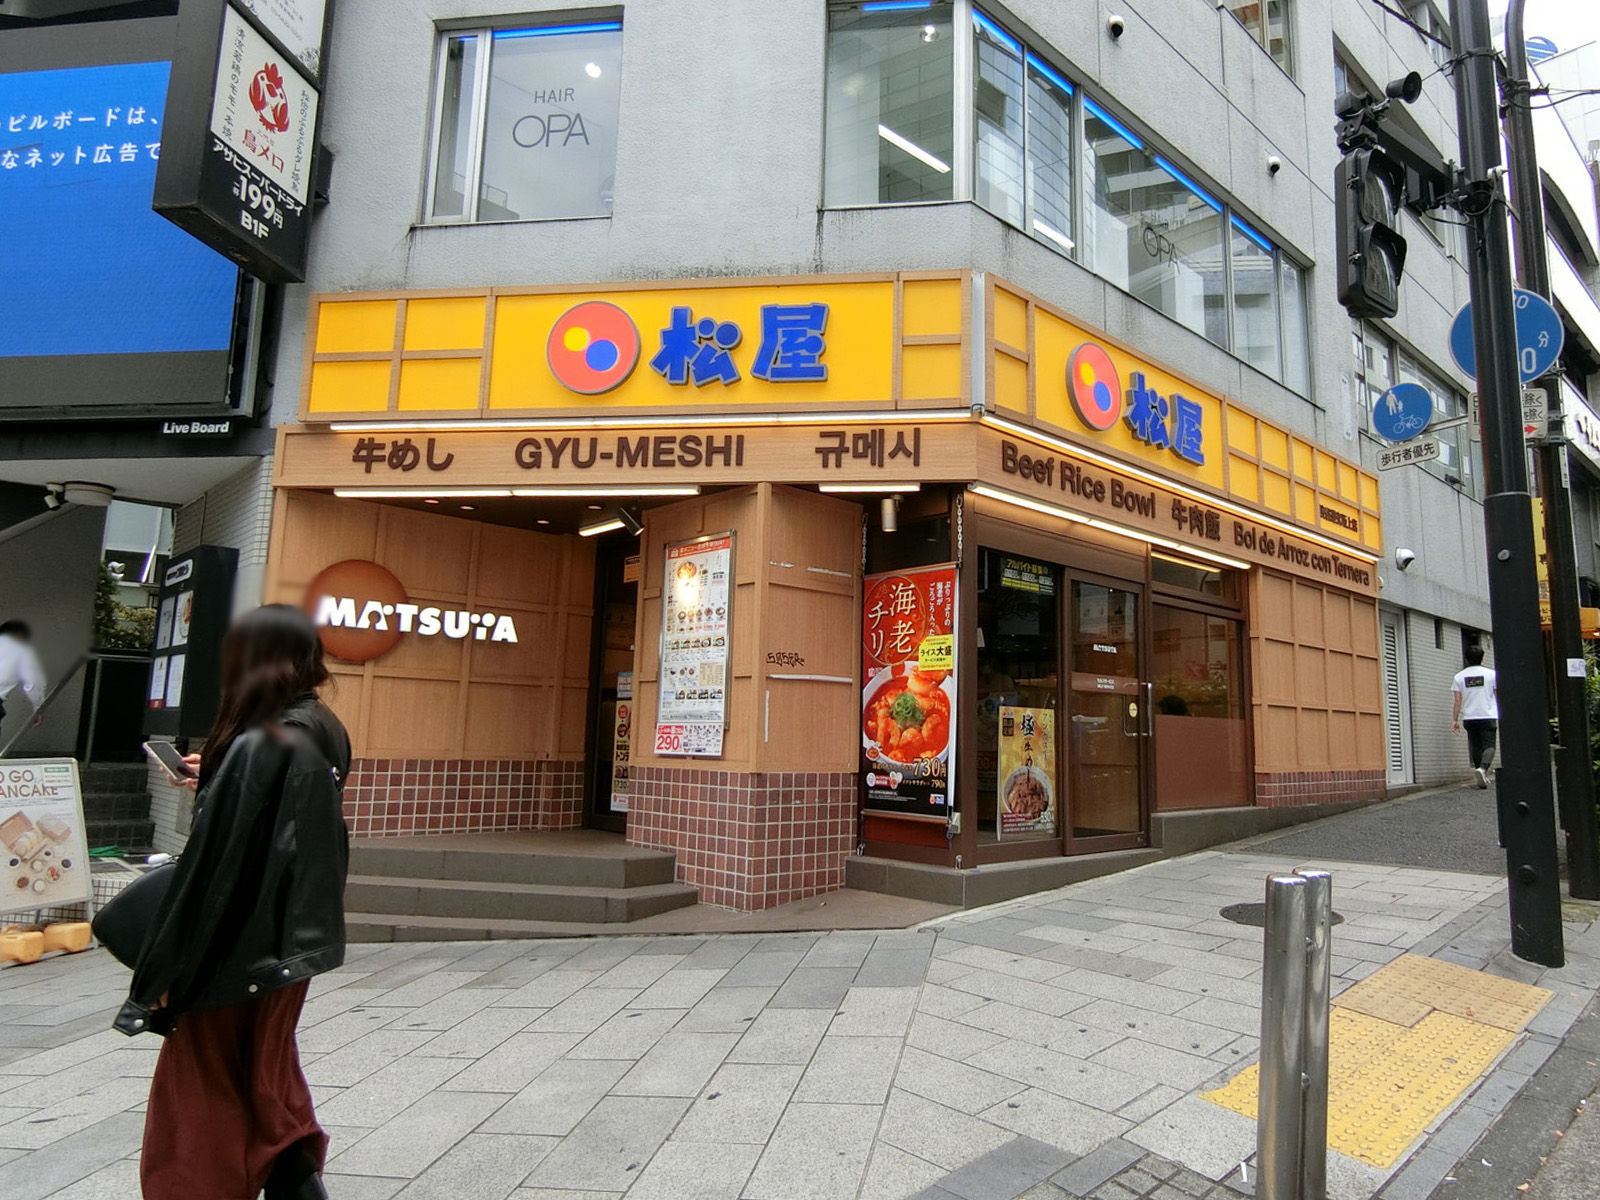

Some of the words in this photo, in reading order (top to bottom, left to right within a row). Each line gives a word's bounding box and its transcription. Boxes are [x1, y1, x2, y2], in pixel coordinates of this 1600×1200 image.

[534, 88, 575, 103] HAIR
[0, 107, 158, 132] ビルボードは、
[512, 113, 590, 148] OPA
[242, 129, 284, 173] 鳥メロ
[213, 139, 303, 217] アサヒスーパードライ
[240, 175, 283, 229] 199円
[241, 210, 269, 238] B1F
[1143, 227, 1180, 275] OPA
[650, 302, 829, 388] 松屋
[1538, 331, 1550, 348] 分
[163, 423, 189, 434] Live
[191, 421, 229, 433] Board
[1122, 371, 1206, 467] 松屋
[353, 437, 454, 473] 牛めし
[514, 434, 745, 470] GYU-MESHI
[815, 427, 922, 468] 규메시
[1381, 442, 1436, 466] 歩行者優先
[1002, 440, 1055, 487] Beef
[1060, 460, 1106, 503] Rice
[1111, 478, 1156, 519] Bowl
[1171, 498, 1220, 541] 牛肉飯
[1234, 521, 1256, 551] Bol
[1259, 531, 1276, 556] de
[1277, 537, 1310, 568] Arroz
[1311, 552, 1331, 575] con
[1332, 555, 1370, 586] Ternera
[315, 595, 518, 643] MATSUYA
[868, 601, 889, 657] チリ
[889, 582, 916, 653] 海老
[920, 646, 952, 657] ライス大盛
[9, 770, 34, 783] GO
